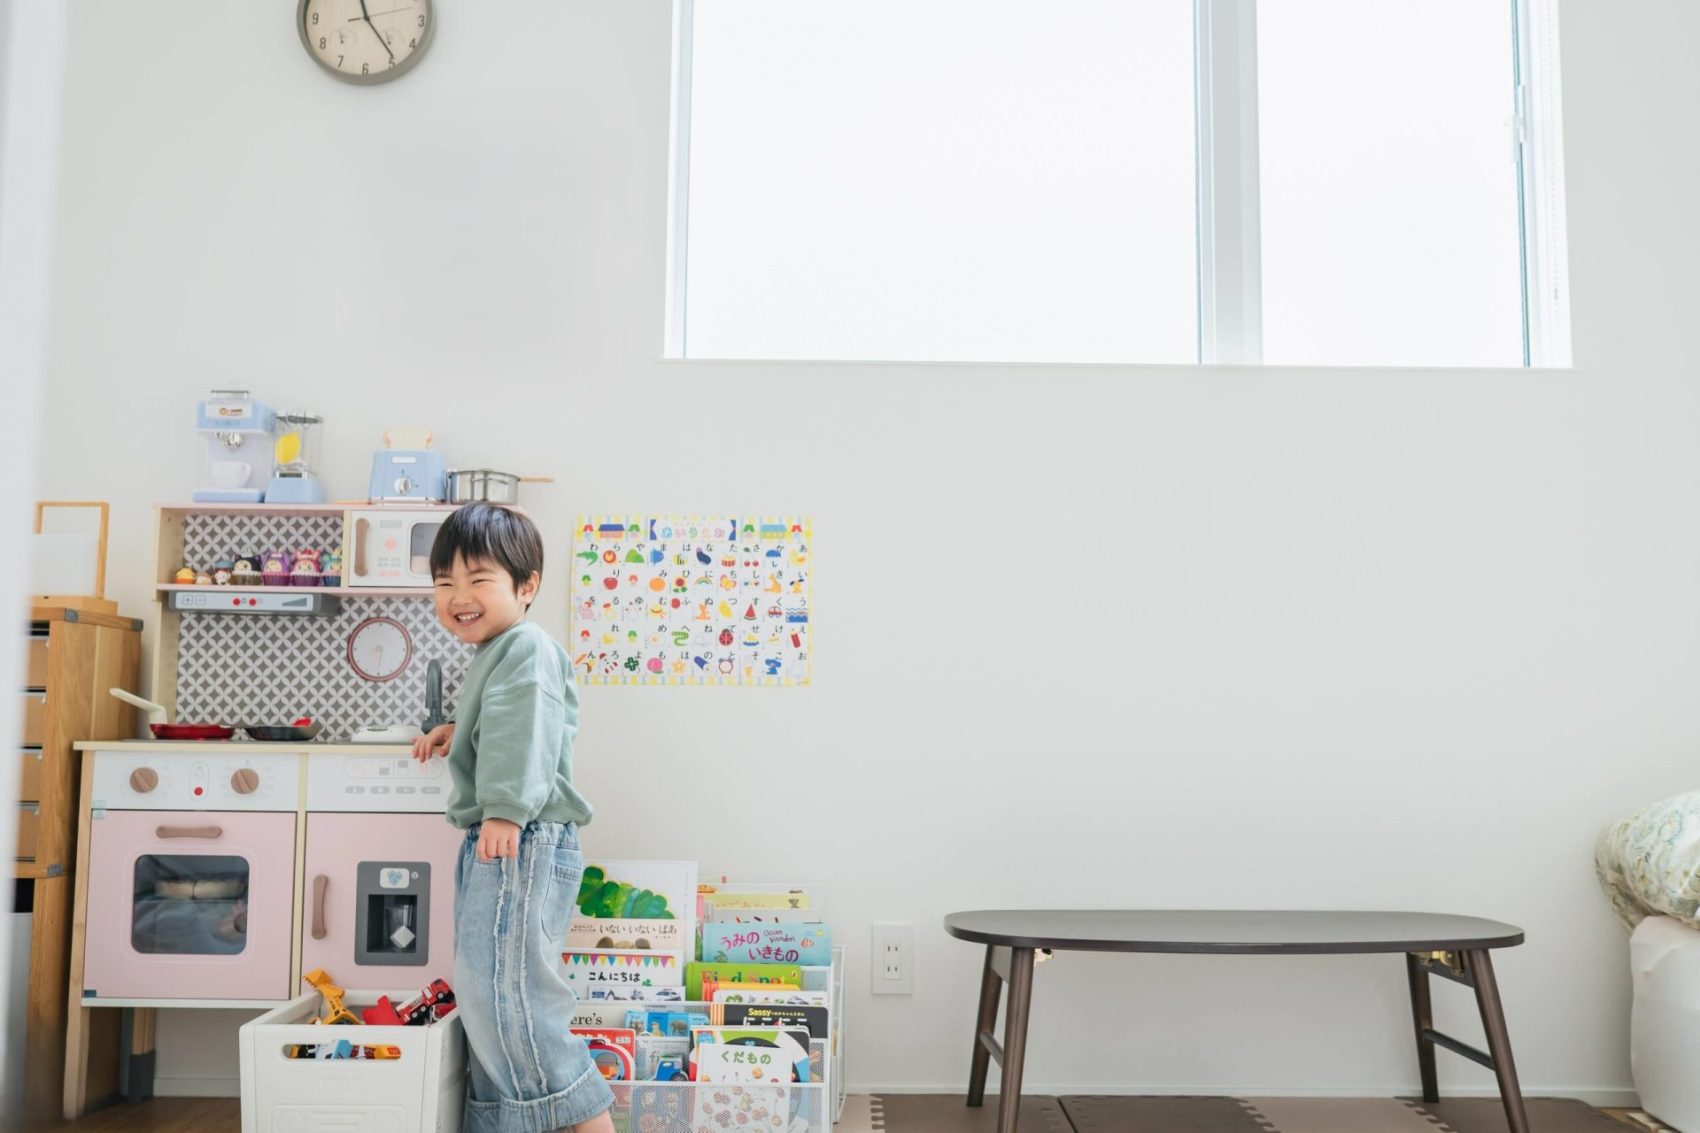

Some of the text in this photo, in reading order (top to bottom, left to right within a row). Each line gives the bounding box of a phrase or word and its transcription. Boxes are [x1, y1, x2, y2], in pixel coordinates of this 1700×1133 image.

[312, 13, 319, 25] 9
[418, 15, 425, 27] 3
[319, 37, 326, 50] 8
[409, 38, 416, 49] 4
[337, 56, 344, 68] 7
[389, 56, 396, 69] 5
[362, 63, 369, 75] 6
[614, 544, 620, 552] ら
[636, 544, 645, 552] や
[660, 544, 668, 552] ま
[683, 544, 691, 552] は
[706, 544, 713, 552] な
[730, 544, 737, 552] た
[754, 544, 760, 552] さ
[776, 544, 784, 552] か
[800, 544, 808, 552] あ
[613, 569, 620, 578] り
[659, 570, 667, 578] み
[682, 570, 690, 578] ひ
[705, 570, 713, 578] に
[730, 570, 737, 579] ち
[753, 570, 760, 578] し
[777, 570, 782, 579] き
[612, 596, 619, 605] る
[635, 596, 643, 604] ゆ
[659, 597, 667, 605] む
[682, 597, 691, 605] ふ
[705, 597, 713, 605] ぬ
[751, 597, 759, 606] す
[776, 597, 782, 606] く
[800, 597, 806, 606] う
[611, 624, 620, 632] れ
[658, 624, 667, 632] め
[705, 625, 713, 633] ね
[752, 625, 759, 633] せ
[775, 625, 783, 633] け
[800, 625, 806, 634] え
[588, 650, 596, 659] ん
[611, 650, 619, 659] ろ
[635, 651, 642, 659] よ
[659, 651, 666, 659] も
[704, 651, 712, 660] の
[728, 651, 735, 661] と
[752, 651, 760, 661] そ
[776, 652, 782, 660] こ
[798, 652, 807, 660] お
[600, 924, 626, 934] いない
[629, 924, 656, 934] いない
[658, 924, 677, 934] ばあ
[720, 932, 760, 950] うみの
[748, 945, 799, 962] いきもの
[588, 972, 640, 982] こんにちは
[748, 1008, 772, 1016] Sassy
[570, 1012, 602, 1026] ere's
[721, 1050, 772, 1064] くだもの
